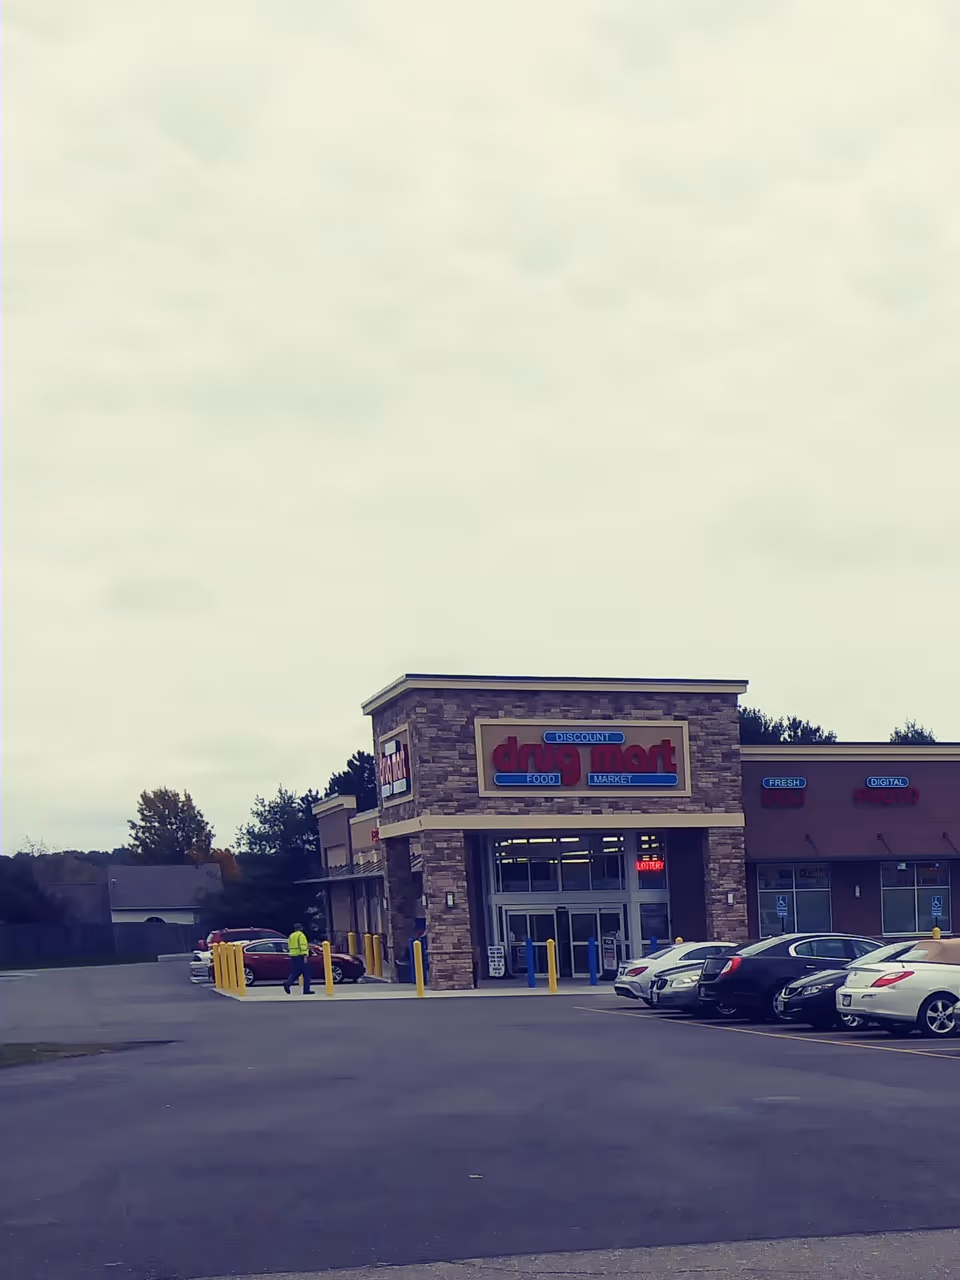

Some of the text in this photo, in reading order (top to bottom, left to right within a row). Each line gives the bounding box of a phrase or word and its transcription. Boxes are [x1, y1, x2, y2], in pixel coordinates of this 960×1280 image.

[555, 733, 610, 742] DISCOUNT
[493, 736, 677, 786] drug mart
[526, 775, 633, 784] FOOD MARKET
[769, 779, 800, 787] FRESH
[870, 778, 904, 786] DIGITAL
[636, 860, 665, 871] LOTTERY
